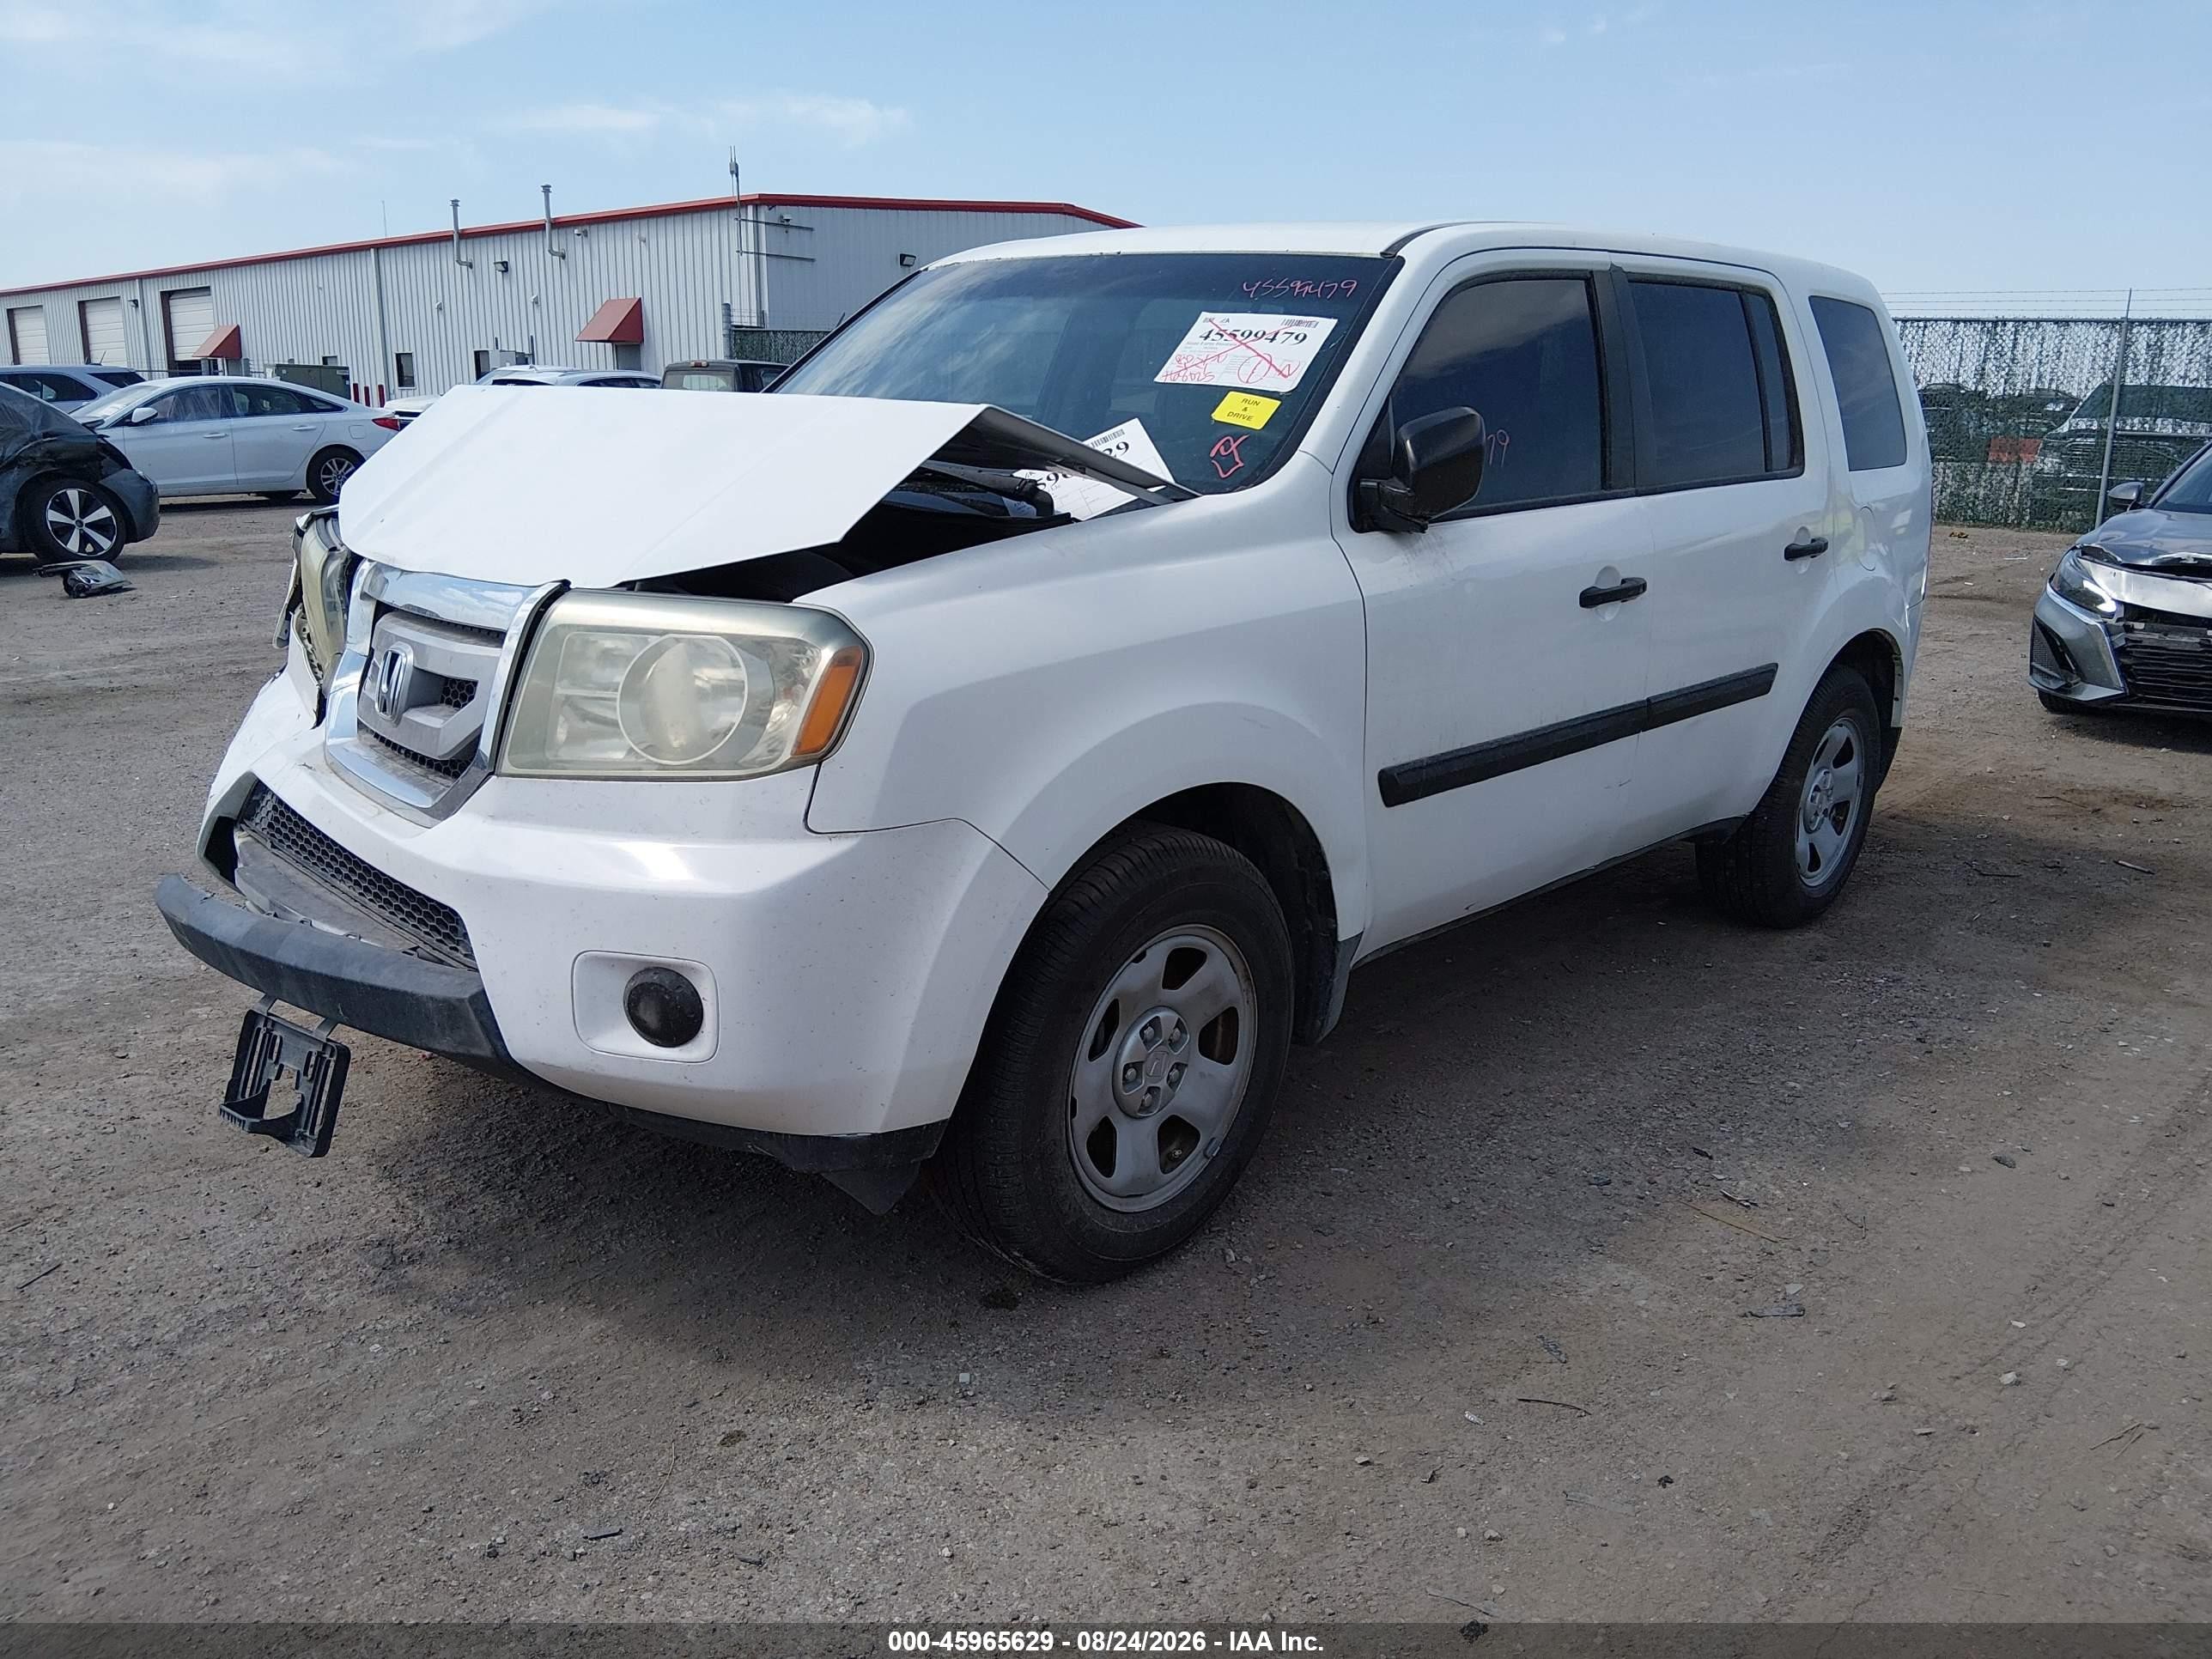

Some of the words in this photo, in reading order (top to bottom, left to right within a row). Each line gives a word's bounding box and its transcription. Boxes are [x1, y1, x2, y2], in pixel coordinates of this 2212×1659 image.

[1199, 329, 1308, 346] 45599479
[1241, 398, 1261, 406] RUN
[1226, 411, 1255, 422] DRIVE
